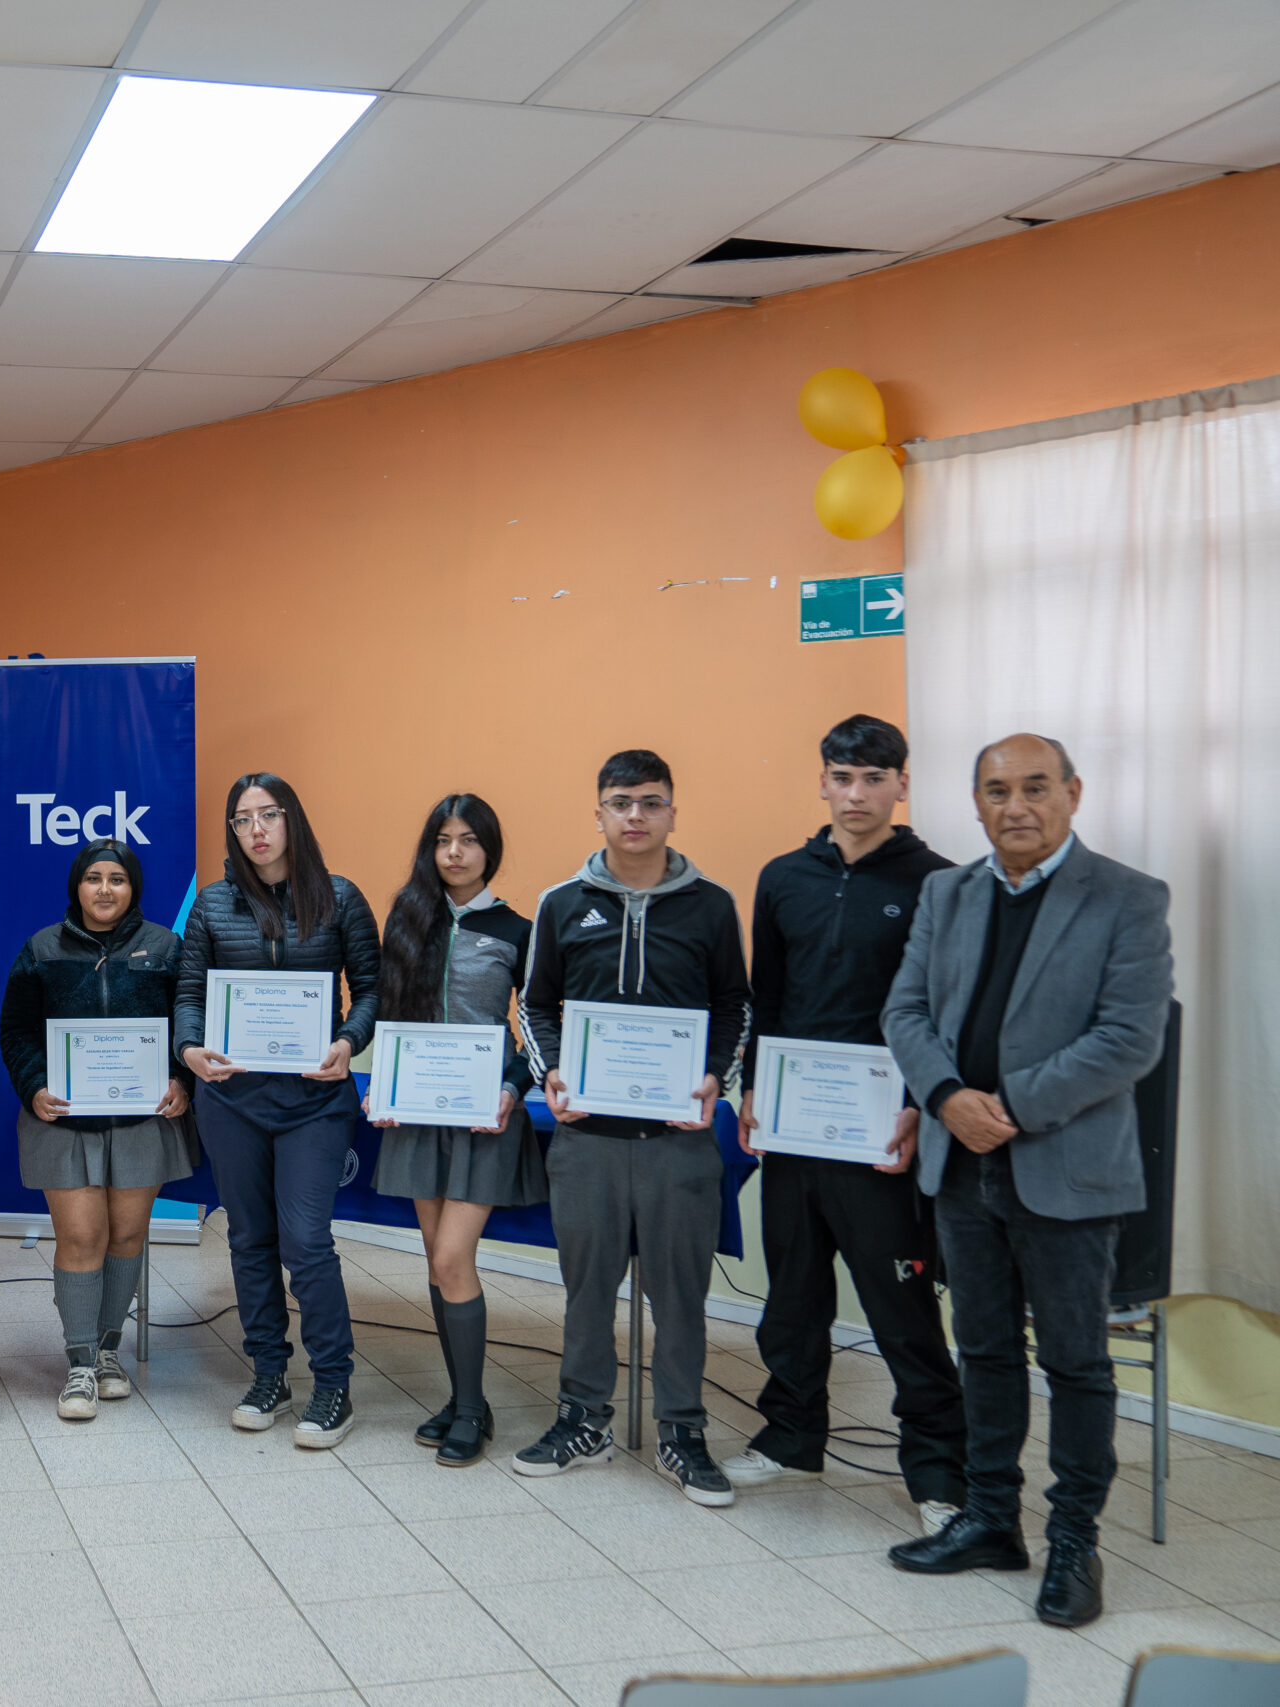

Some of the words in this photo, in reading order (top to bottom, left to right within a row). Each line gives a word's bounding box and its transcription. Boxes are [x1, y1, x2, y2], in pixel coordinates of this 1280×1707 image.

[16, 790, 151, 845] Teck
[255, 987, 287, 996] Diploma
[302, 990, 319, 999] Teck
[93, 1035, 125, 1043] Diploma
[139, 1036, 156, 1044] Teck
